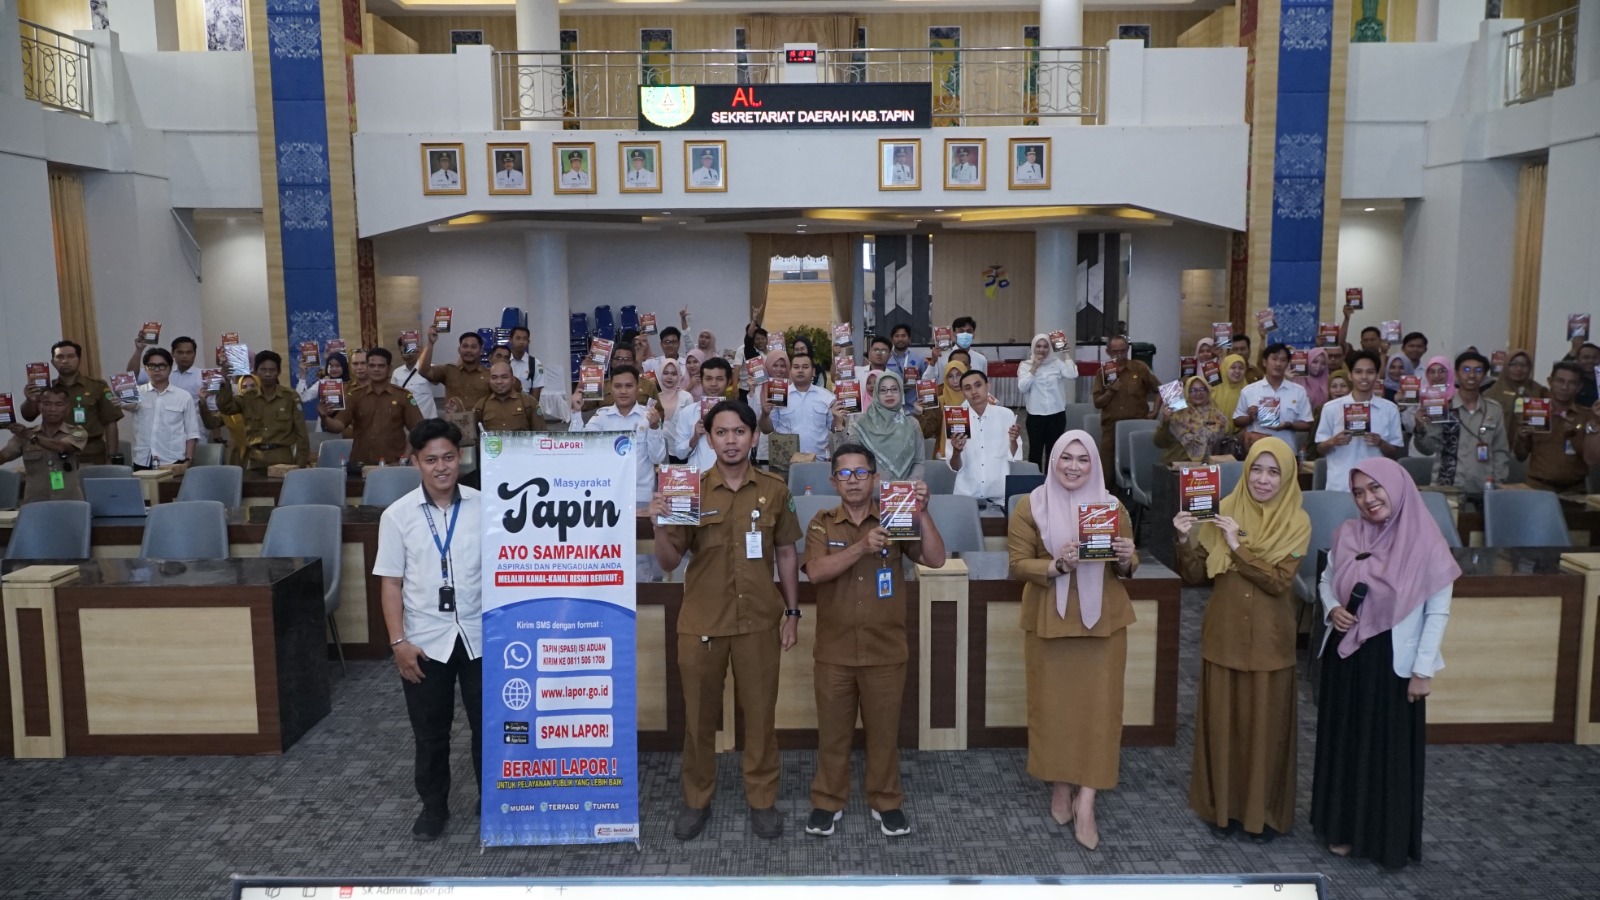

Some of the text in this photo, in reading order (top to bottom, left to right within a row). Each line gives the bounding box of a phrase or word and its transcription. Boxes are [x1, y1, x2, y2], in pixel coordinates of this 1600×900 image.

[712, 110, 914, 124] SEKRETARIAT DAERAH KAB.TAPIN
[554, 440, 584, 450] LAPOR!
[554, 478, 611, 489] Masyarakat
[498, 478, 620, 542] Tapin
[498, 544, 621, 560] AYO SAMPAIKAN
[600, 562, 622, 570] ANDA
[498, 574, 525, 583] MELALUI
[526, 574, 568, 583] KANAL-KANAL
[570, 574, 590, 582] RESMI
[590, 574, 618, 582] BERIKUT
[516, 621, 534, 630] Kirim
[536, 621, 550, 630] SMS
[552, 621, 576, 631] dengan
[577, 620, 599, 629] format
[542, 645, 558, 653] TAPIN
[558, 644, 578, 654] (SPASI)
[586, 644, 606, 652] ADUAN
[543, 657, 558, 665] KIRIM
[558, 657, 566, 665] KE
[567, 656, 580, 665] 0811
[542, 685, 608, 700] www.lapor.go.id
[542, 724, 608, 740] SP4N LAPOR!
[502, 760, 556, 778] BERANI
[560, 758, 608, 776] LAPOR
[496, 781, 515, 789] UNTUK
[518, 780, 551, 788] PELAYANAN
[510, 804, 534, 812] MUDAH
[376, 886, 407, 894] Admin
[410, 886, 454, 896] Lapor.pdf
